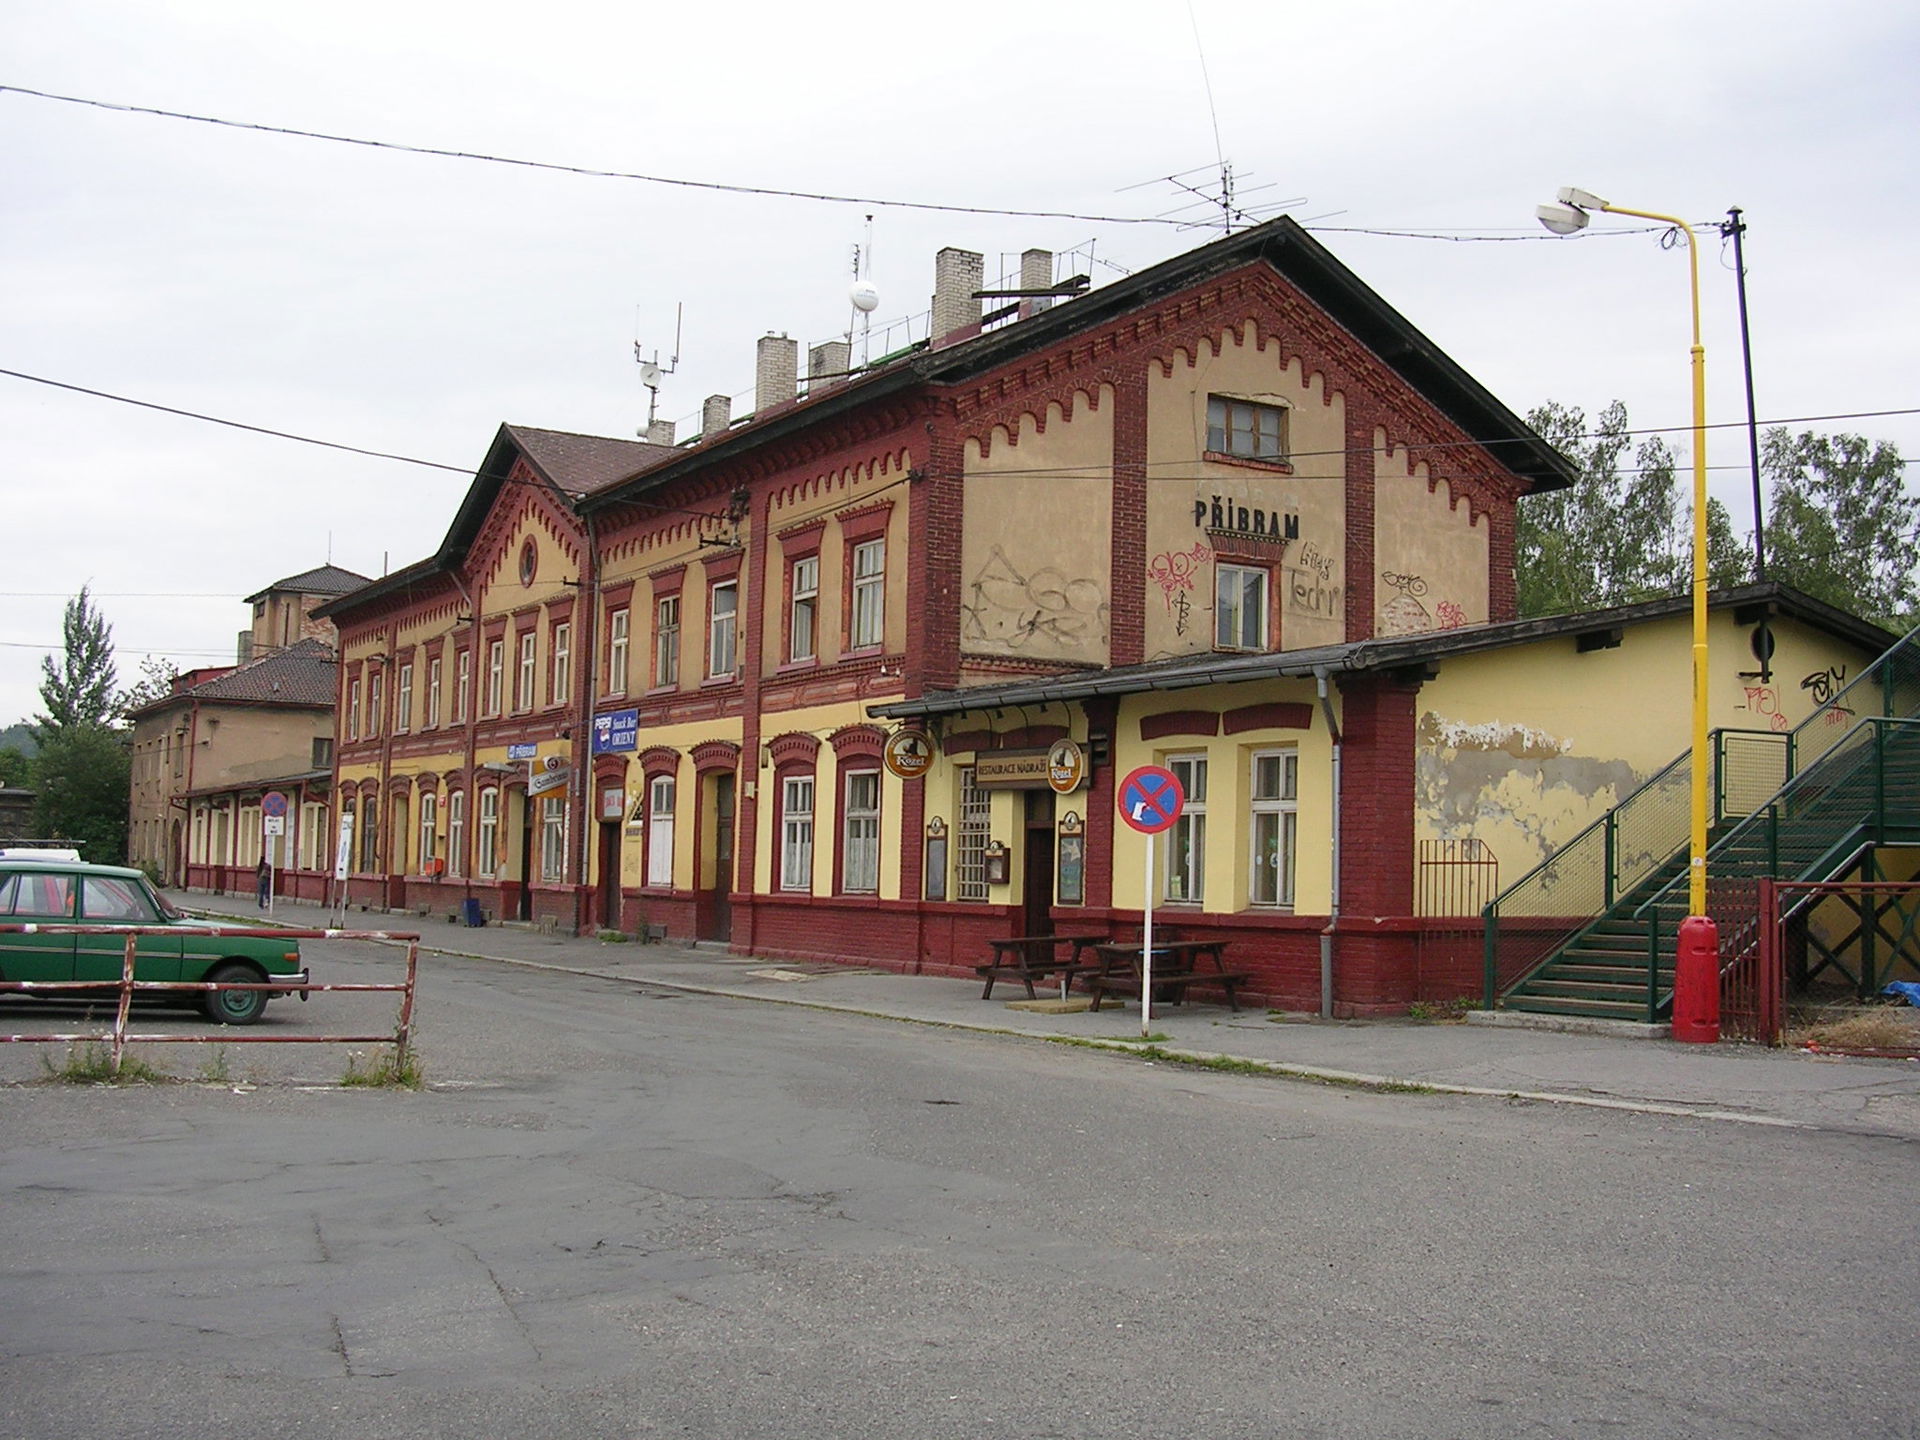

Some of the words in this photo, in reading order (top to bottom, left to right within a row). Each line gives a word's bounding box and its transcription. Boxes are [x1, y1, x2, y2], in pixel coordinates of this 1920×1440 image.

[1195, 494, 1299, 540] PŘÍBRAM
[595, 717, 612, 730] PEPSI
[612, 731, 636, 745] ORIENT
[896, 755, 925, 767] Kozel
[978, 763, 1016, 775] RESTAURACE
